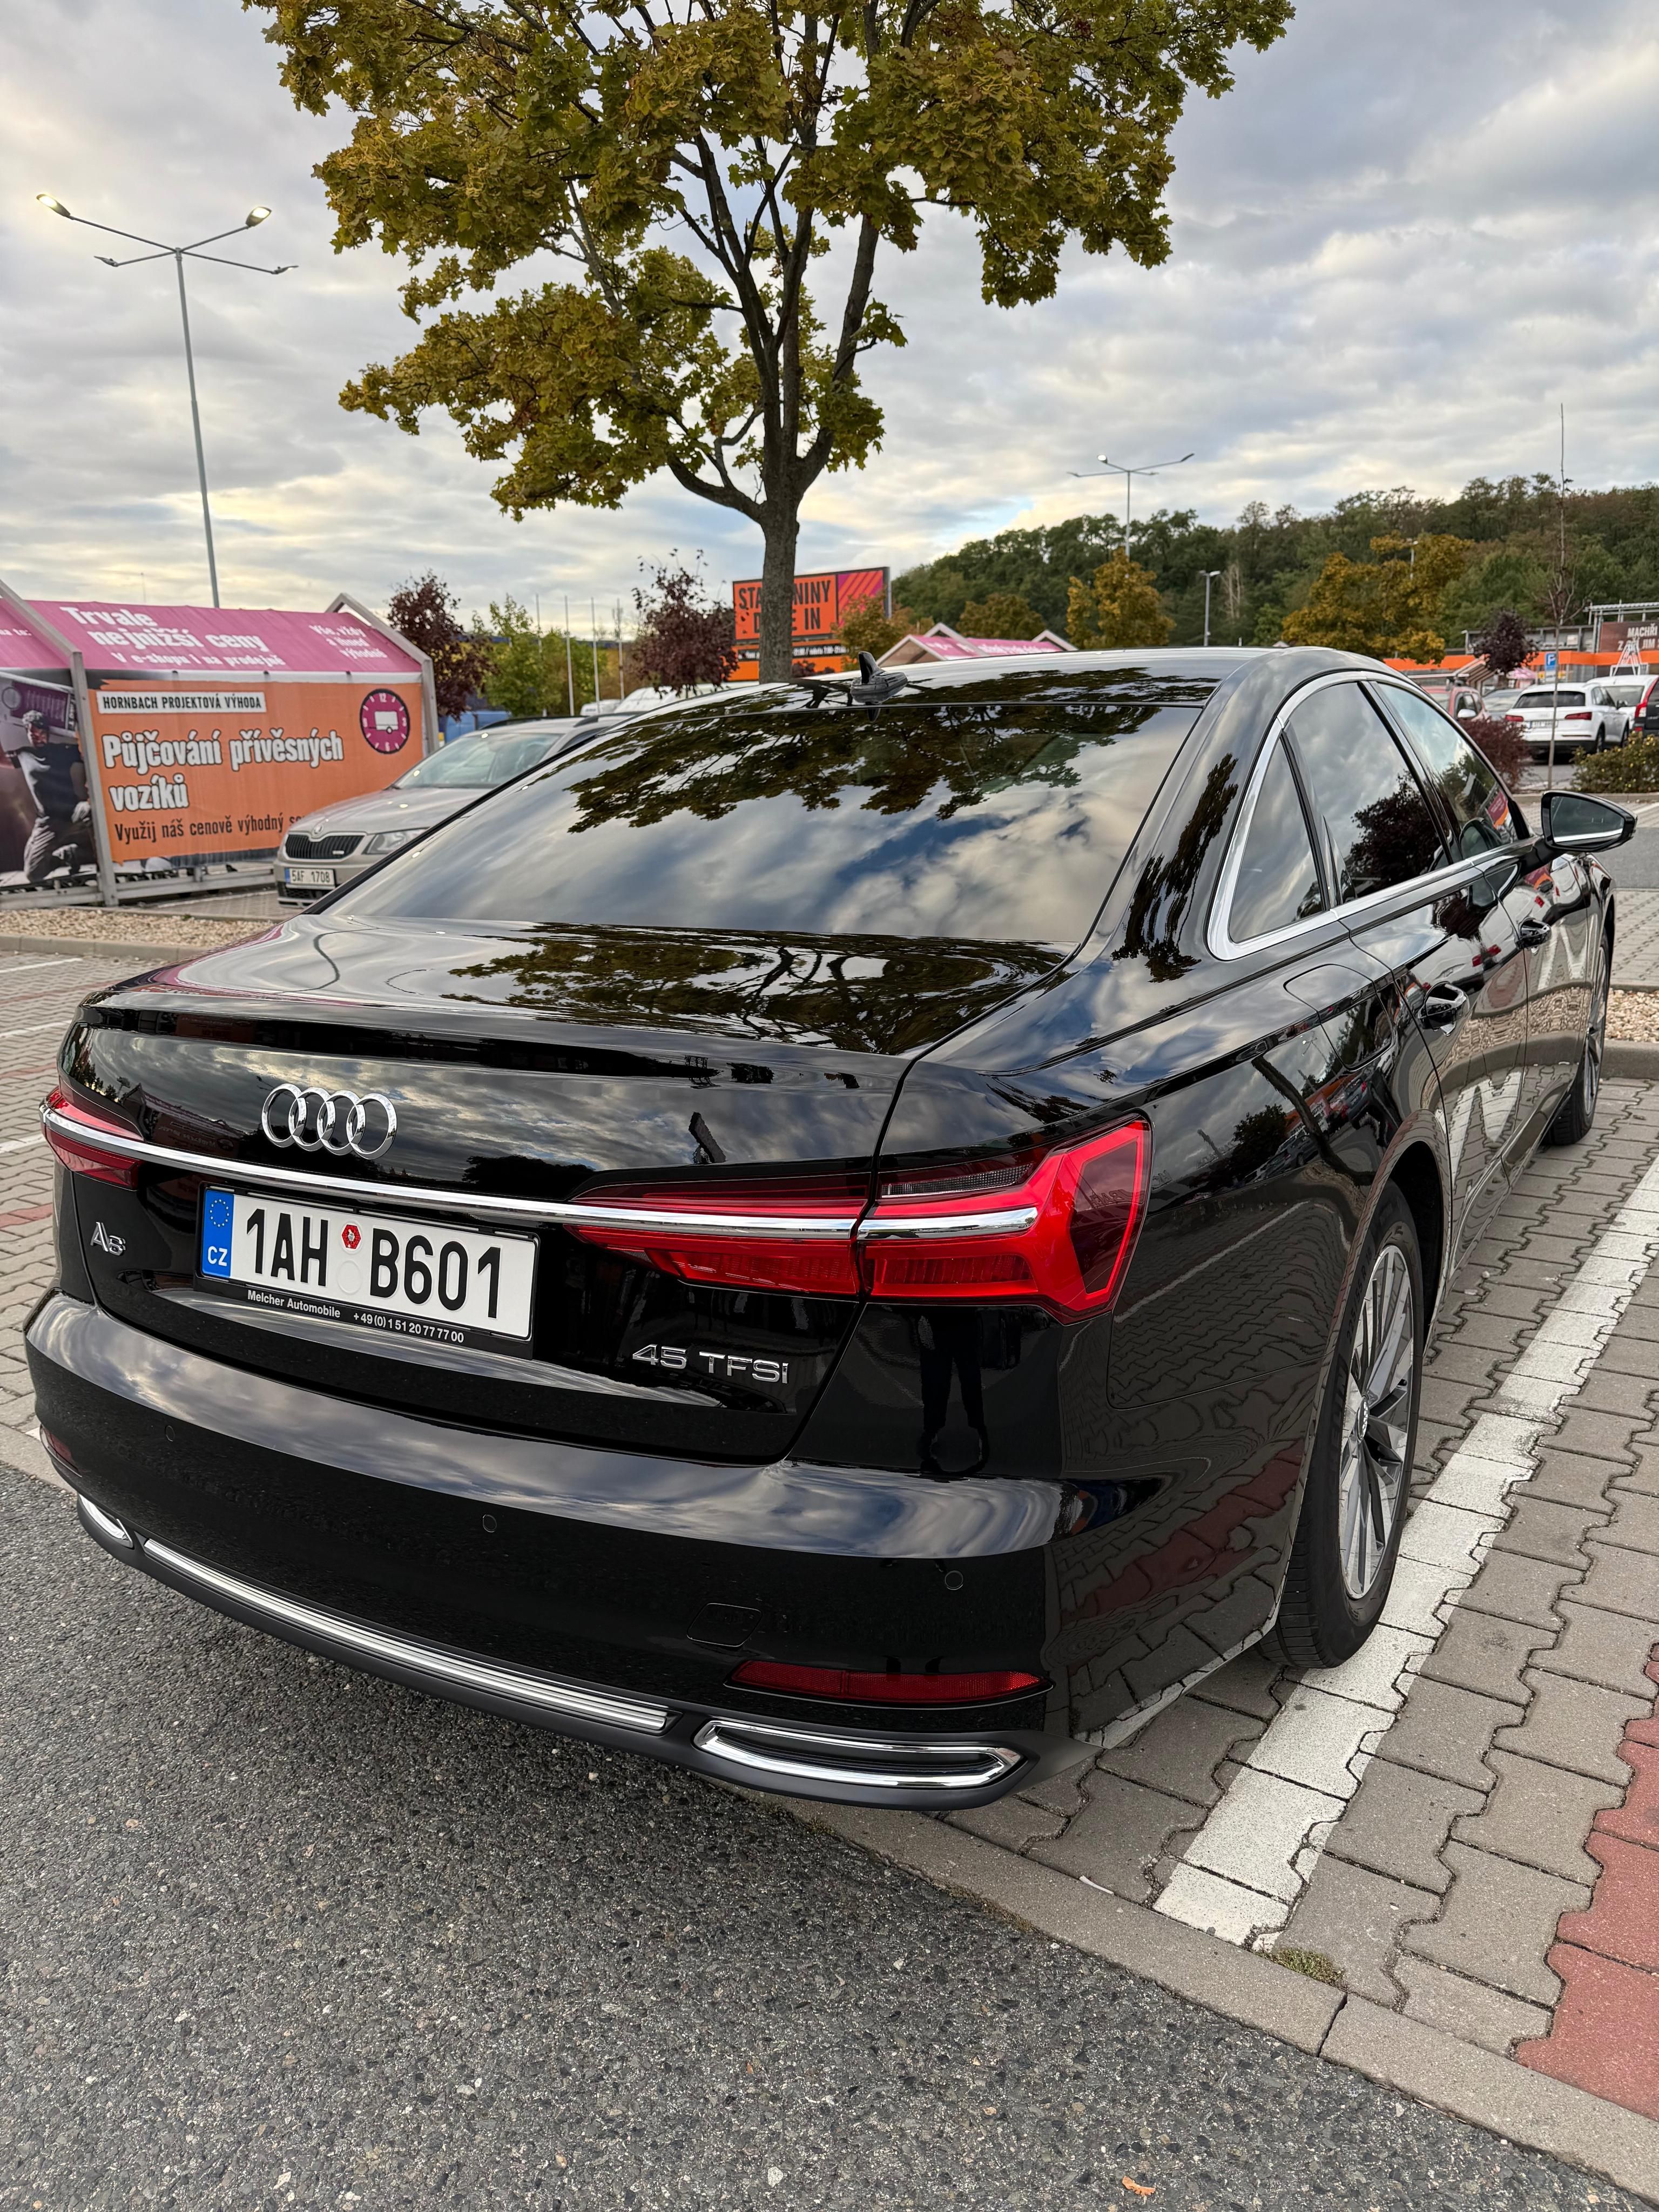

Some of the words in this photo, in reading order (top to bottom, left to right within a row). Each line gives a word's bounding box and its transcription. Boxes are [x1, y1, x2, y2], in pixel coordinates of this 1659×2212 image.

[738, 580, 831, 610] STANINY
[59, 606, 158, 626] Trvale
[804, 607, 821, 630] IN
[1627, 623, 1658, 638] MACHŘI
[205, 634, 269, 652] ceny
[103, 696, 158, 709] HORNBACH
[163, 693, 221, 709] PROJEKTOVÁ
[225, 693, 262, 709] VÝHODA
[102, 729, 223, 775] Půjčování
[228, 727, 345, 772] přívěsných
[109, 773, 190, 812] vozíků
[114, 820, 157, 845] Využij
[162, 818, 184, 838] náš
[190, 815, 233, 835] cenově
[238, 812, 284, 836] výhodný
[311, 871, 330, 882] 1708
[90, 1221, 126, 1256] A6
[207, 1245, 228, 1266] CZ
[247, 1208, 329, 1287] 1AH
[369, 1228, 501, 1319] B601
[247, 1289, 285, 1306] Melcher
[286, 1297, 341, 1318] Automobile
[632, 1344, 687, 1370] 45
[699, 1351, 789, 1384] TFSI
